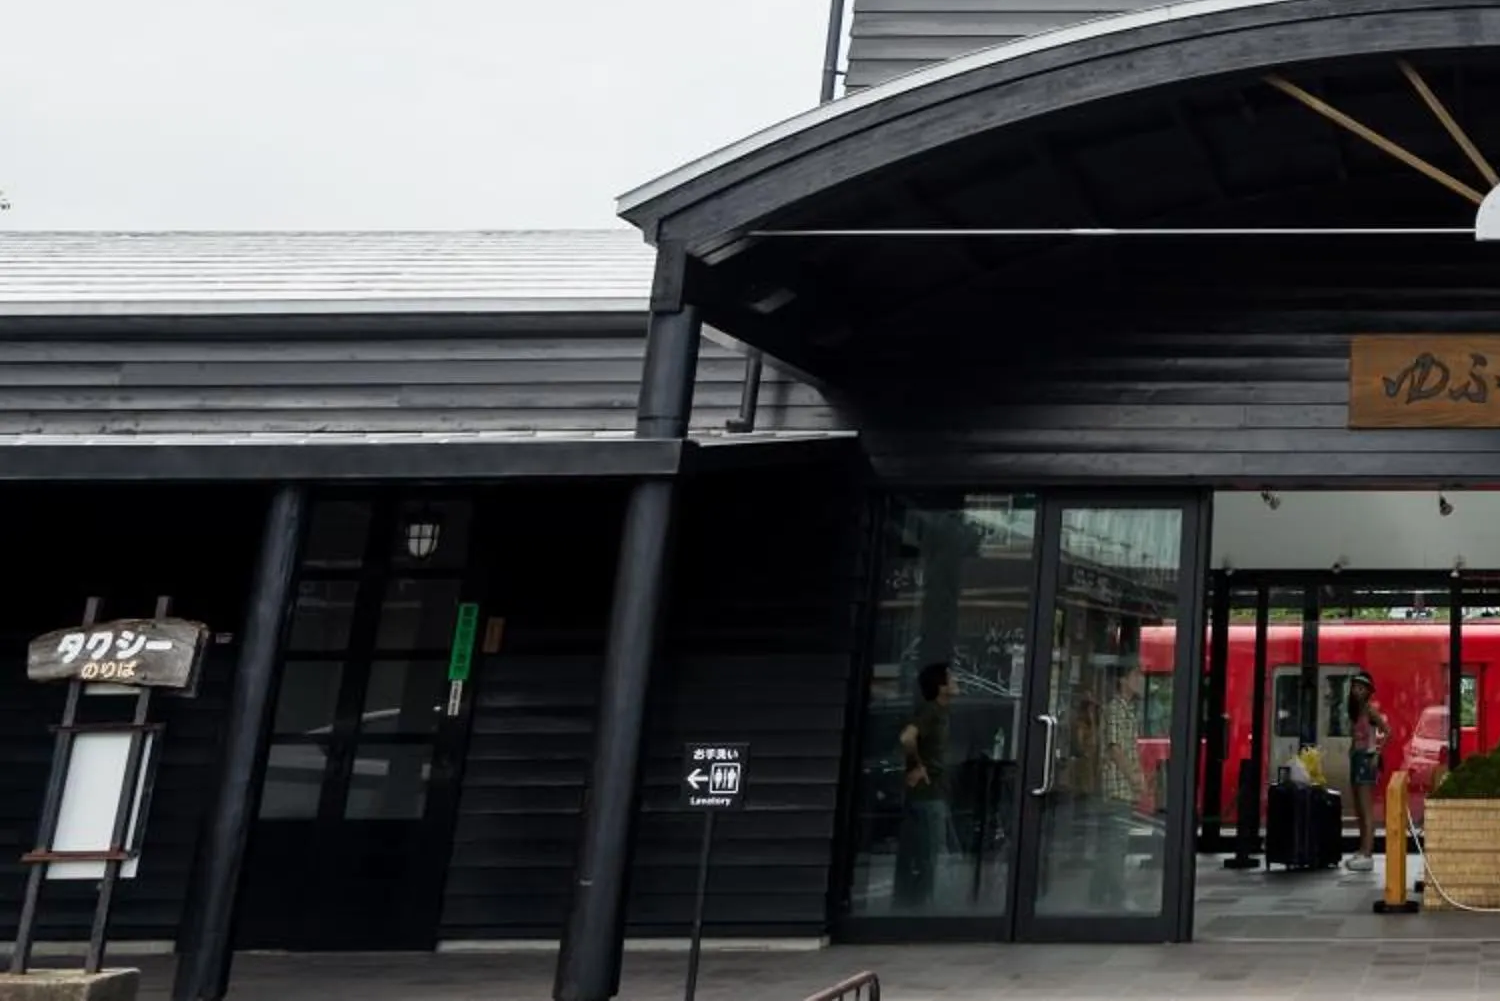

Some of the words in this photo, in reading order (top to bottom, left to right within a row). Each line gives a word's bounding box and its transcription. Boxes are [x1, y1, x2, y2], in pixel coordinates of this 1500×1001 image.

[57, 630, 173, 663] タクシー
[81, 660, 137, 680] のりば
